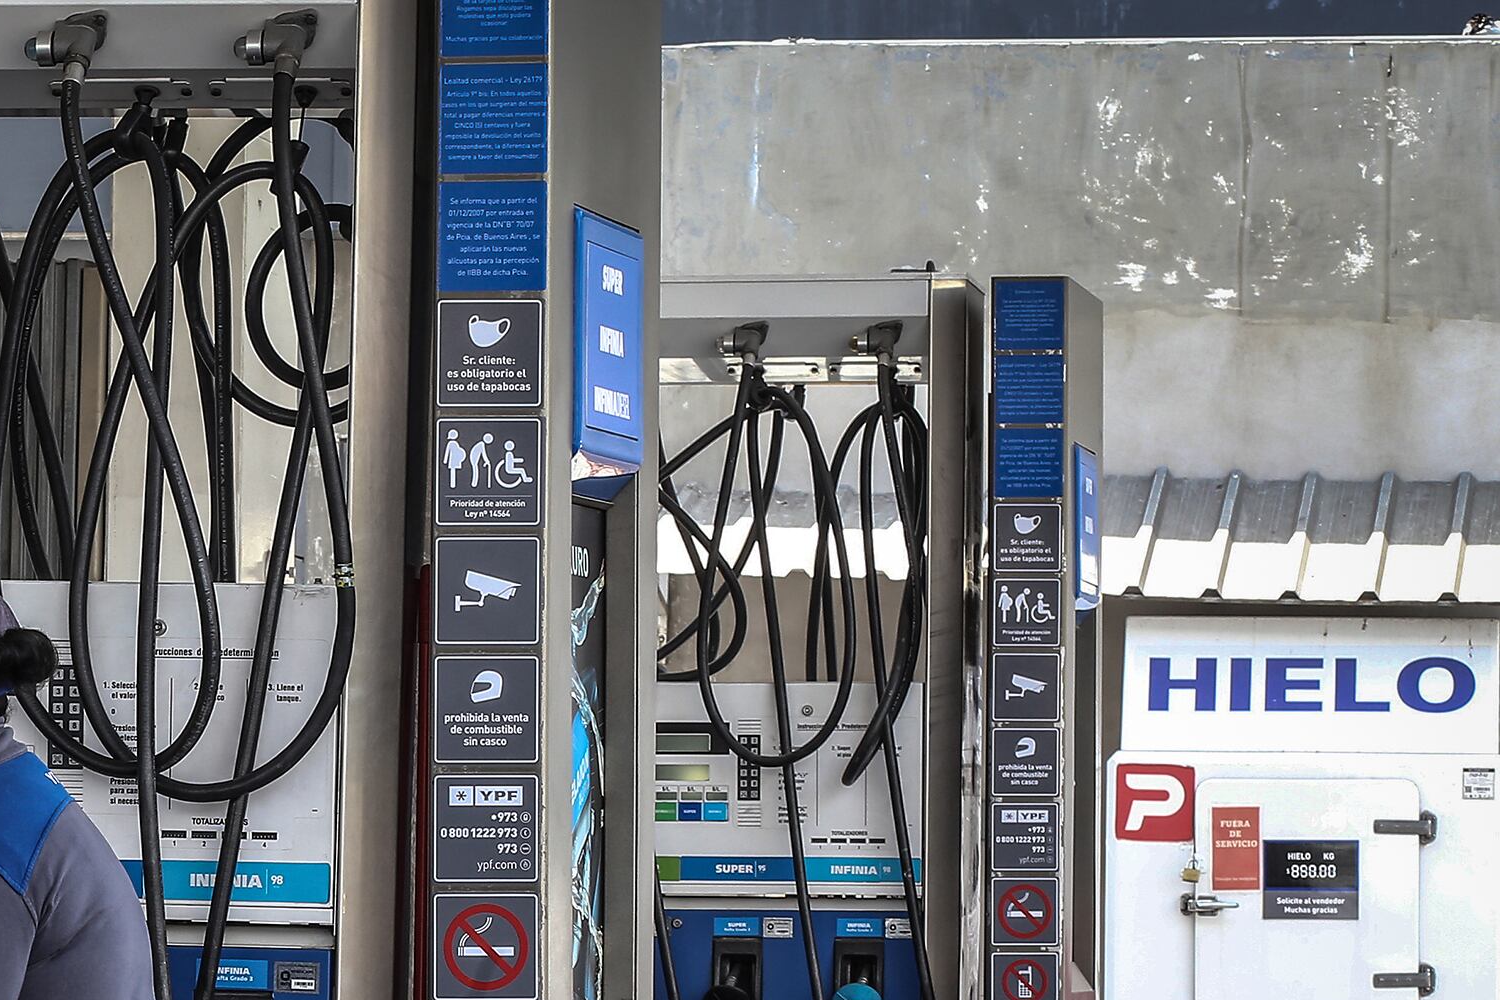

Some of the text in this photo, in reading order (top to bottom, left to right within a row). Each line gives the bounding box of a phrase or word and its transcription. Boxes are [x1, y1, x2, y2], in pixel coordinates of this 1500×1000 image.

[510, 76, 522, 84] Ley
[487, 198, 500, 206] que
[506, 197, 526, 205] partir
[448, 209, 484, 217] 01/12/2007
[446, 222, 473, 230] vigencia
[463, 355, 516, 365] Sr. cliente:
[446, 368, 526, 380] es obligatorio el
[446, 381, 531, 393] uso de tapabocas
[450, 499, 526, 507] Prioridad de atención
[464, 510, 478, 519] Ley
[489, 510, 511, 518] 14564
[1009, 547, 1043, 555] obligatorio
[571, 546, 589, 578] URO
[1022, 555, 1054, 563] tapabocas
[276, 684, 294, 692] Llene
[296, 684, 304, 692] el
[1147, 656, 1476, 714] HIELO
[444, 713, 529, 724] prohibida la venta
[450, 724, 523, 734] de combustible
[463, 736, 507, 746] sin casco
[480, 790, 518, 801] YPF
[1021, 812, 1046, 820] YPF
[1220, 819, 1251, 828] FUERA
[1229, 830, 1242, 838] DE
[497, 843, 518, 853] 973
[1215, 840, 1258, 848] SERVICIO
[1287, 852, 1335, 861] HIELO KG
[477, 859, 517, 872] ypf.com
[715, 864, 754, 874] SUPER
[830, 865, 877, 875] INFINIA
[270, 875, 284, 885] 98
[1276, 897, 1345, 905] Solicite al vendedor
[1284, 906, 1338, 915] Muchas gracias
